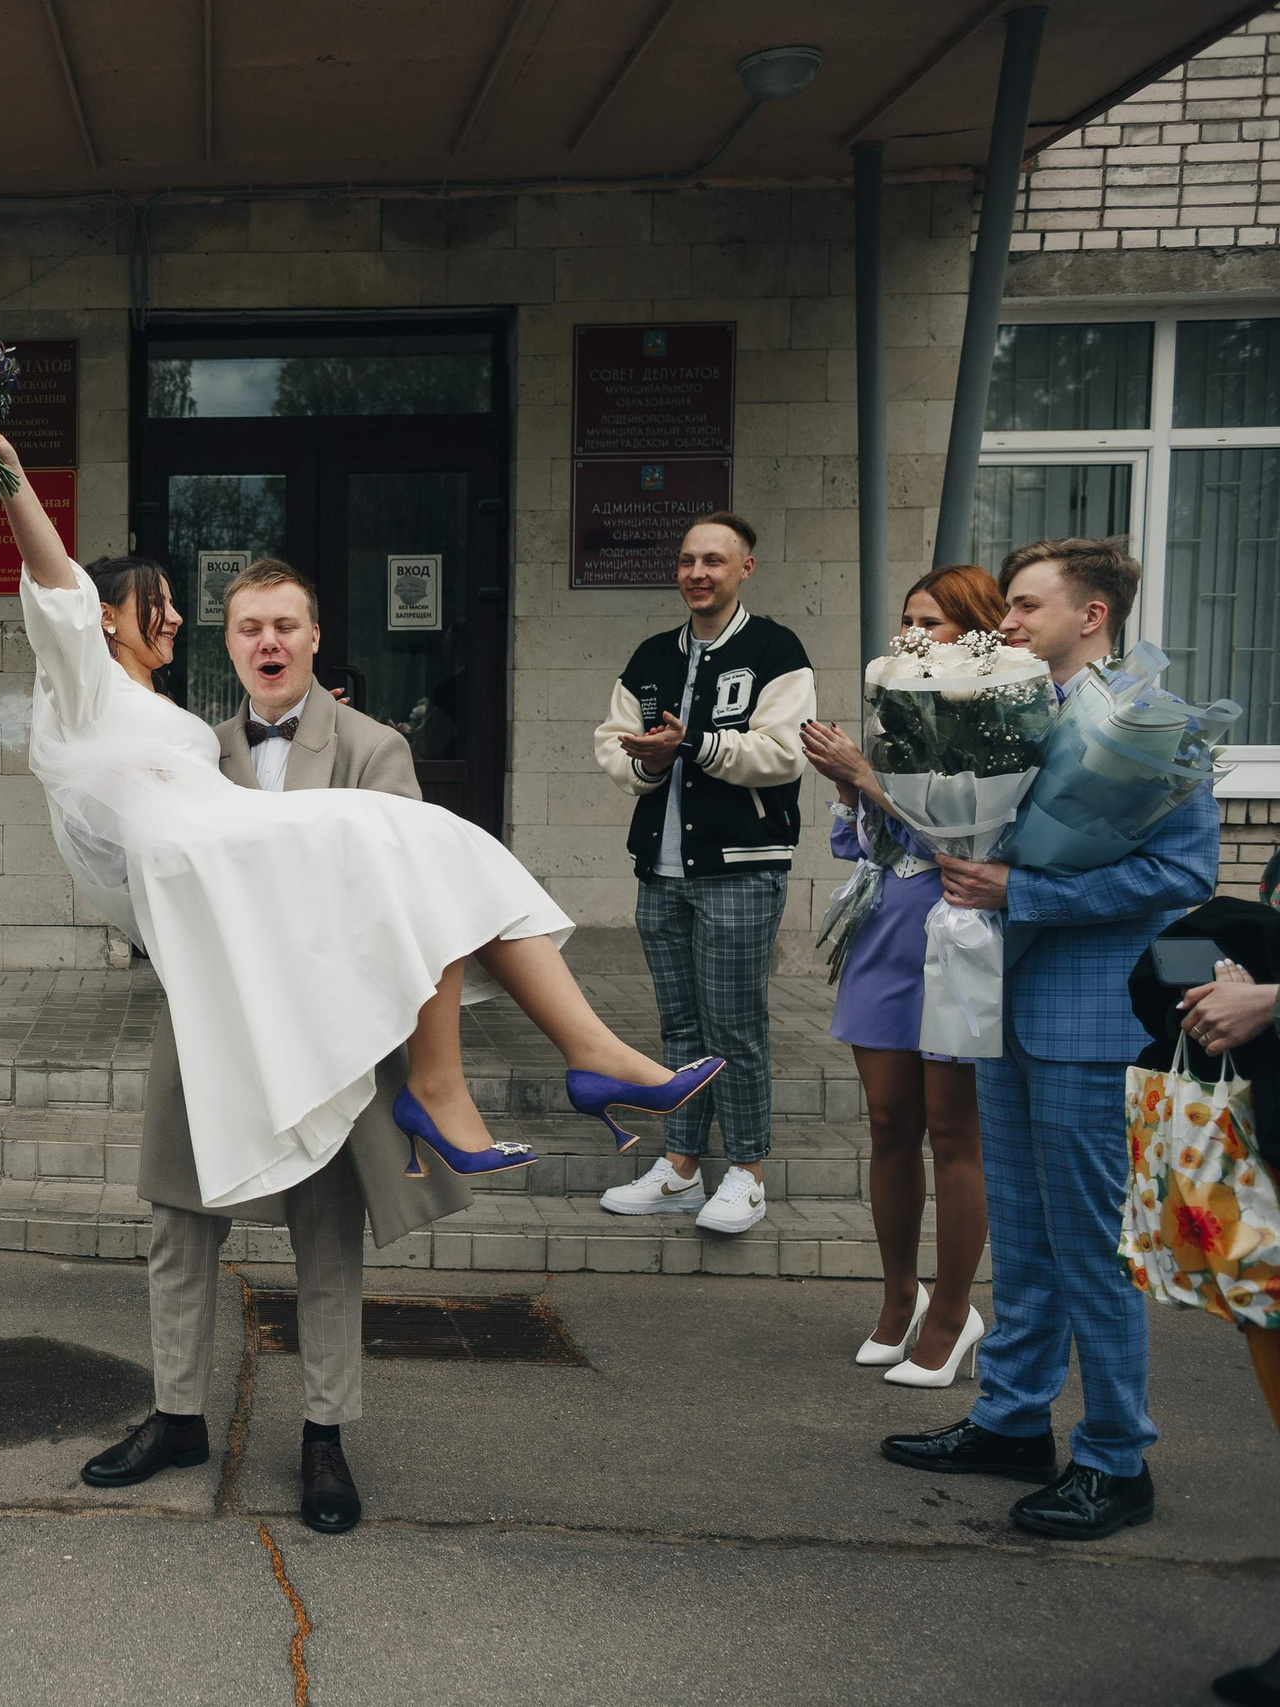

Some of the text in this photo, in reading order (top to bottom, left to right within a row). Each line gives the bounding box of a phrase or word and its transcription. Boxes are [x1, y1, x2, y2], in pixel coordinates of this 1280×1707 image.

[589, 366, 721, 381] СОВЕТ ДЕПУТАТОВ
[605, 383, 703, 395] МУНИЦИПАЛЬНОГО
[11, 394, 66, 404] ОСЕЛЕНИЯ
[616, 396, 692, 408] ОБРАЗОВАНИЯ
[586, 425, 721, 438] МУНИЦИПАЛЬНЫЙ РАЙОН
[584, 437, 724, 450] ЛЕНИНГРАДСКОЙ ОБЛАСТИ
[592, 500, 715, 515] АДМИНИСТРАЦИЯ
[603, 517, 692, 528] МУНИЦИПАЛЬНОГ
[612, 531, 684, 541] ОБРАЗОВАНИ
[599, 546, 680, 558] ЛОДЕЙНОПОЛЬС
[207, 561, 240, 573] ВХОД
[585, 559, 676, 570] МУНИЦИПАЛЬНЫЙ
[397, 566, 431, 578] ВХОД
[583, 571, 666, 582] ЛЕНИНГРАДСКОЙ
[395, 612, 432, 620] ЗАПРЕЩЕН
